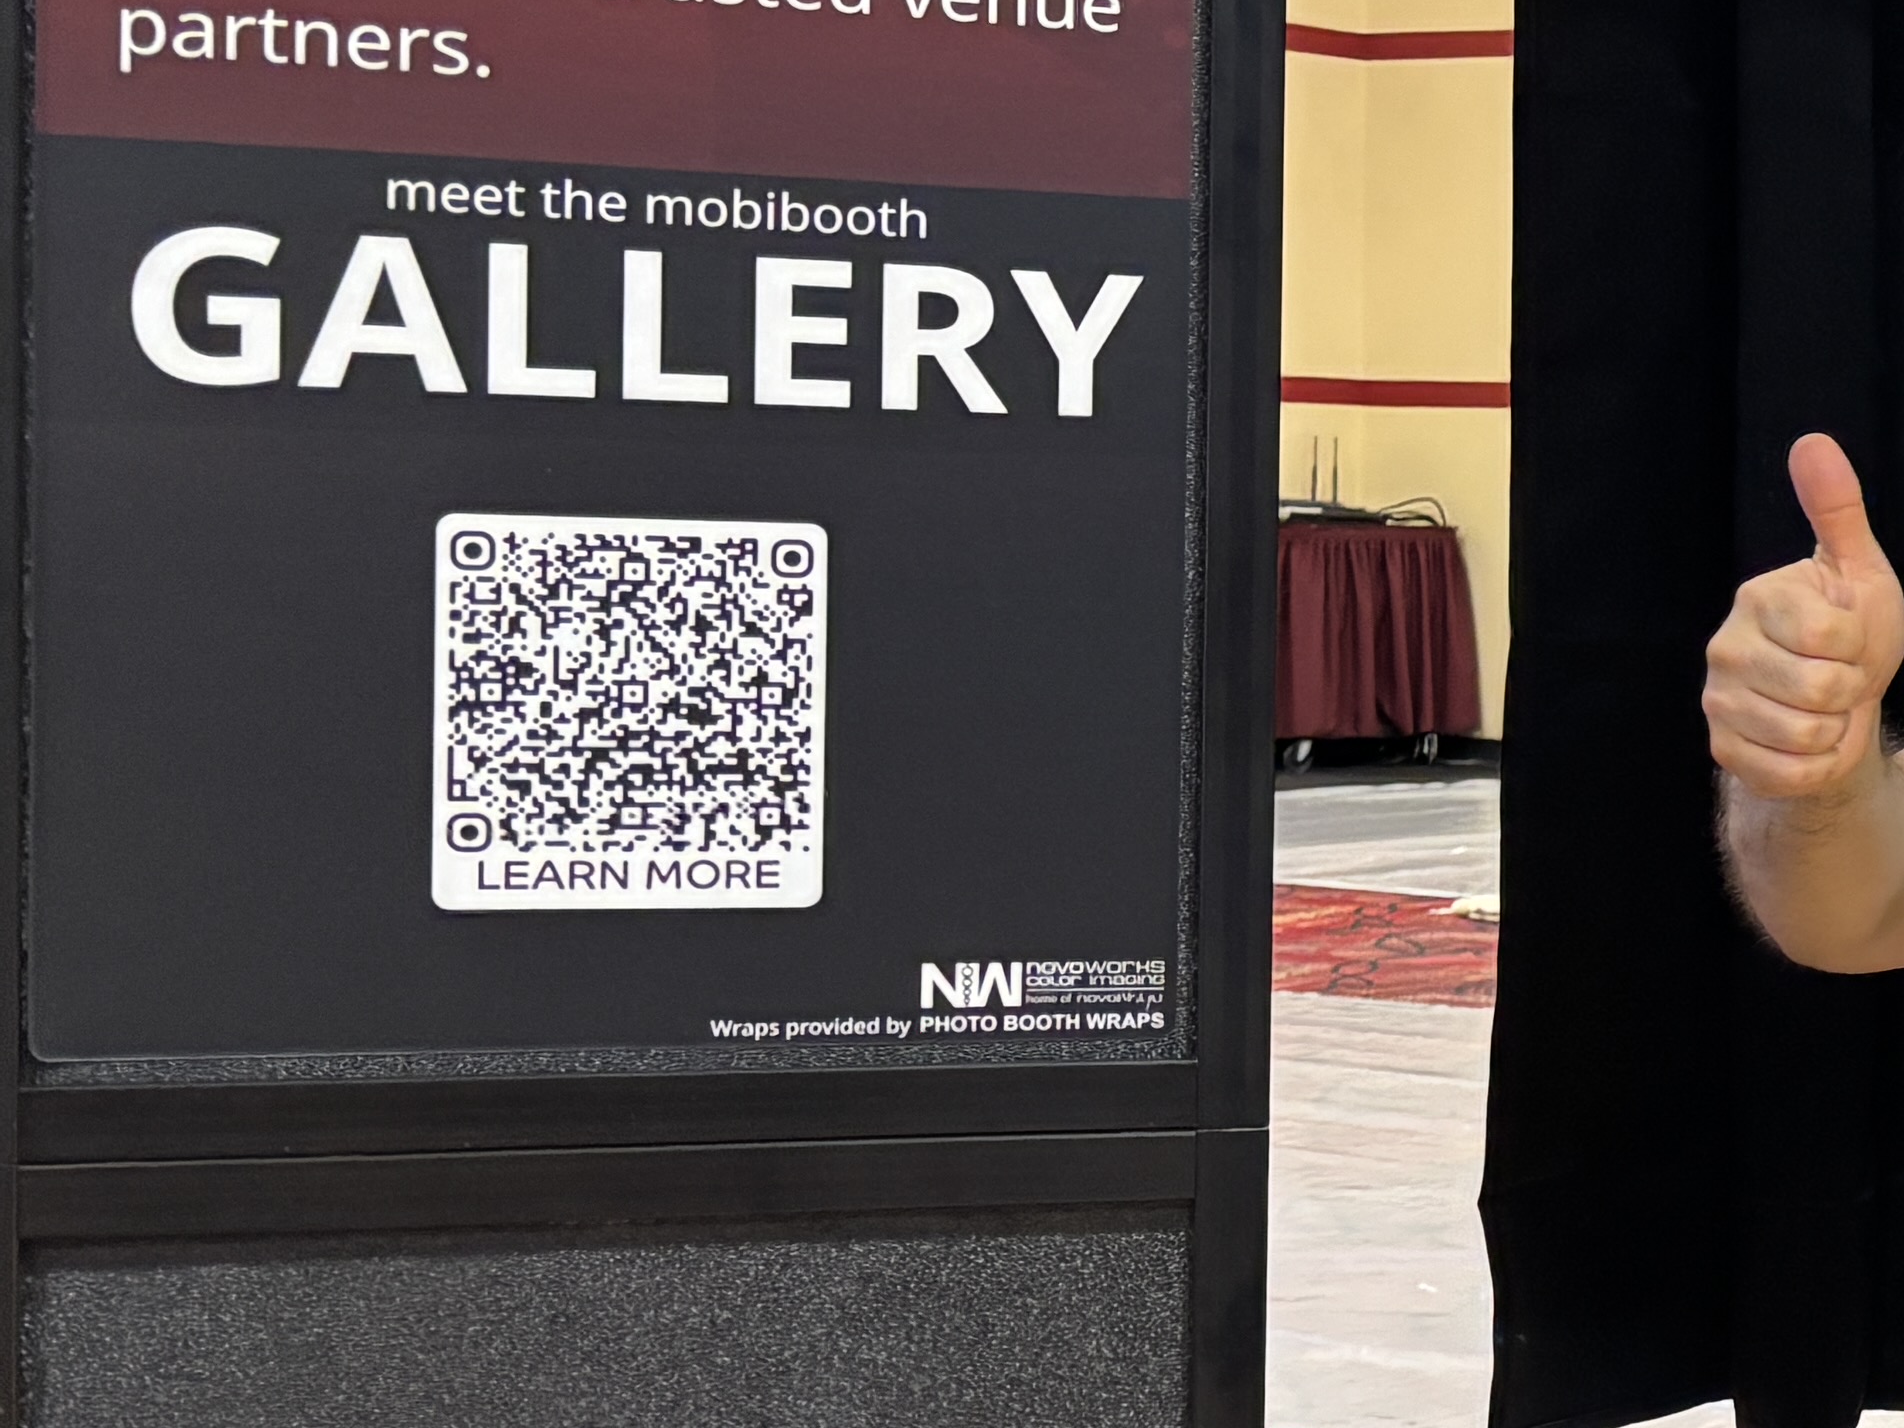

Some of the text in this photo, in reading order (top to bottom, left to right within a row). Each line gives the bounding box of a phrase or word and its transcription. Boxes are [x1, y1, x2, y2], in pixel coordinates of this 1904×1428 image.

[119, 7, 492, 79] partners.
[386, 175, 928, 241] meet the mobibooth
[130, 224, 1146, 419] GALLERY
[476, 859, 780, 892] LEARN MORE
[711, 1012, 1164, 1040] Wraps provided by PHOTO BOOTH WRAPS
